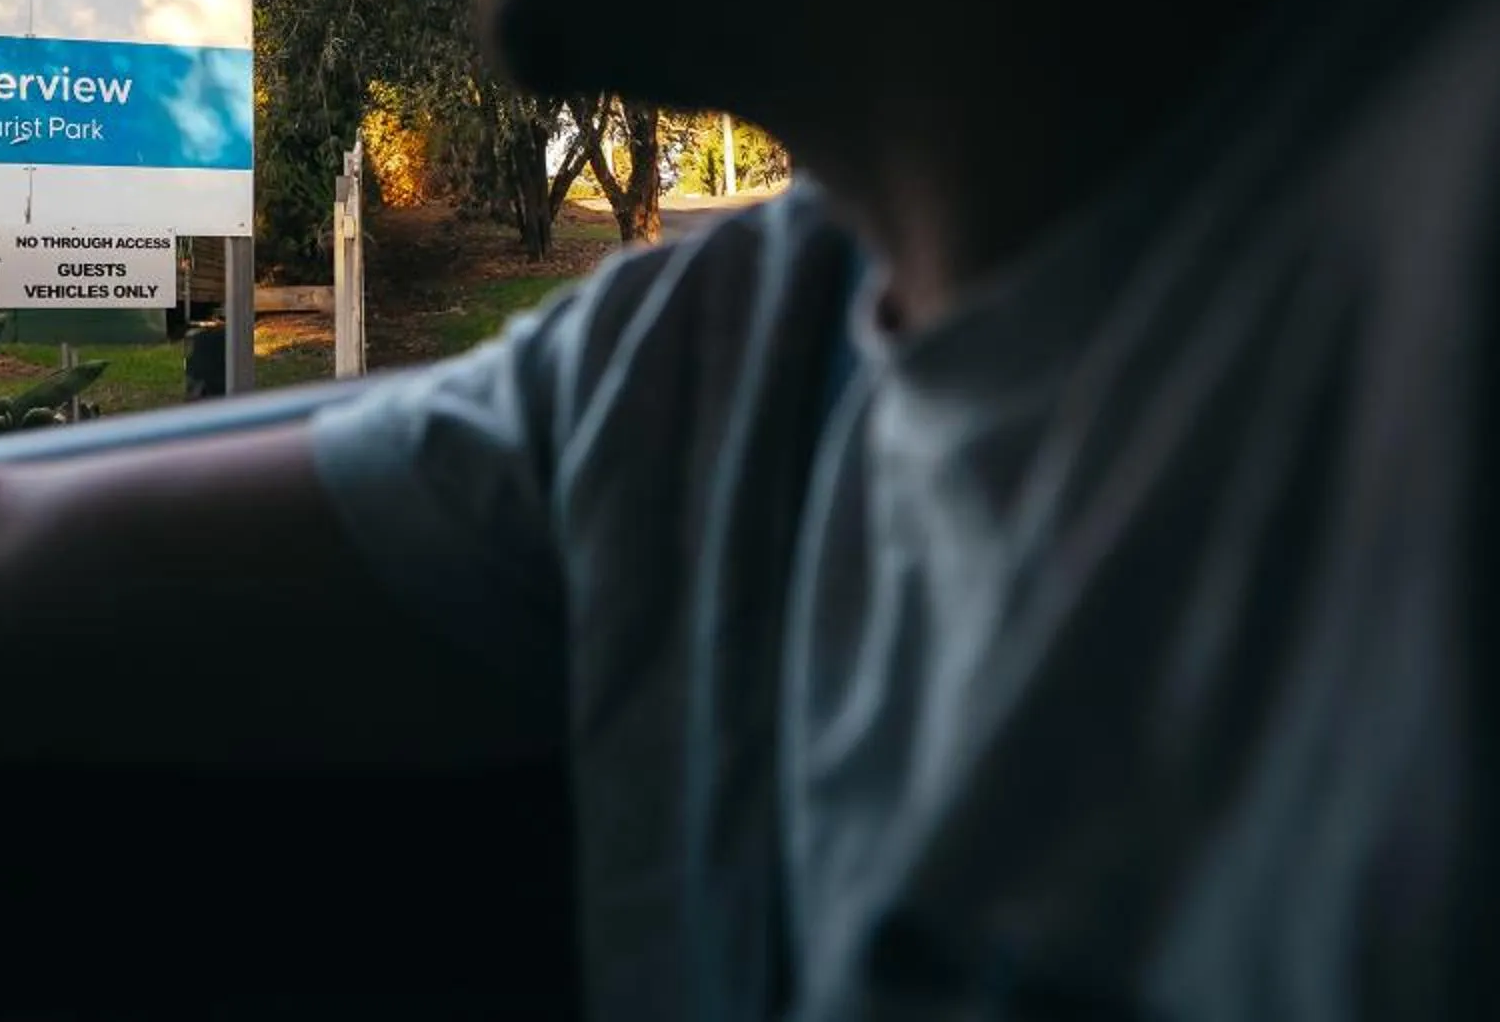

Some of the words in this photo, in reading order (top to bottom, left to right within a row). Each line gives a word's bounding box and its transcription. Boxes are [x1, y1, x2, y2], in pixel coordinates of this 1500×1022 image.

[49, 116, 104, 140] Park
[16, 236, 38, 248] NO
[41, 236, 113, 249] THROUGH
[115, 237, 171, 249] ACCESS
[57, 263, 127, 277] GUESTS
[24, 285, 109, 299] VEHICLES
[113, 285, 158, 299] ONLY
